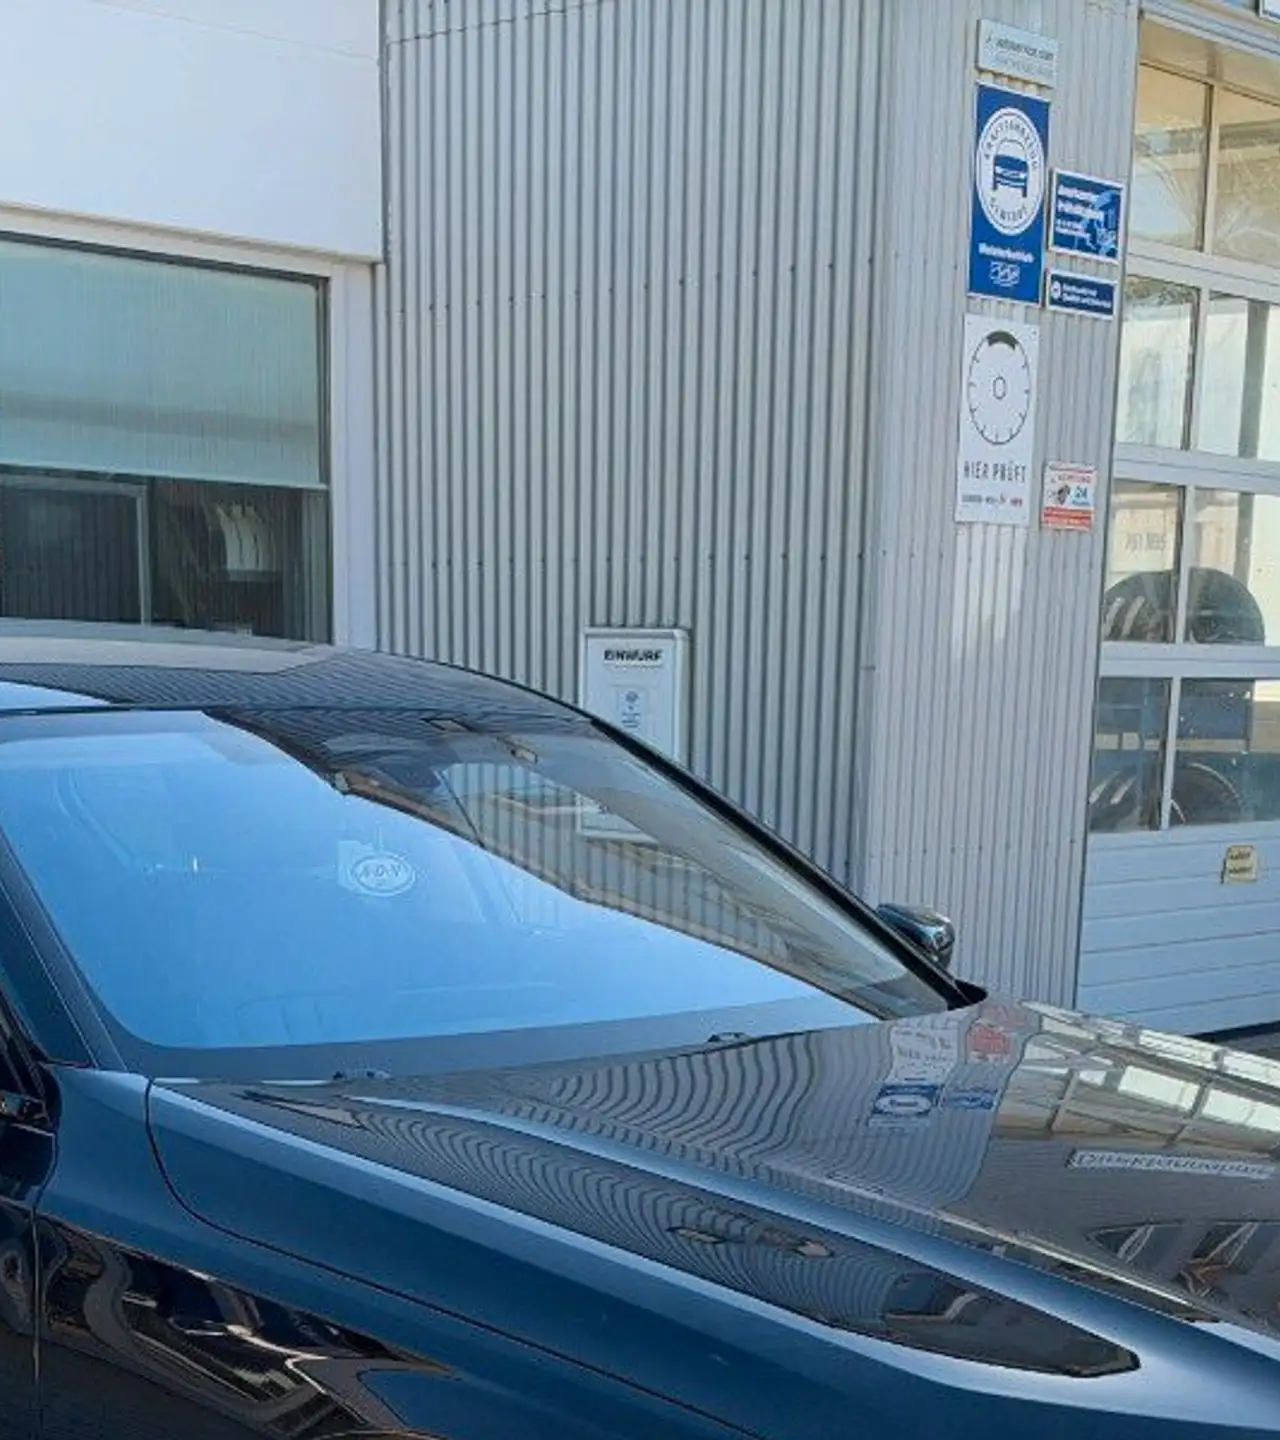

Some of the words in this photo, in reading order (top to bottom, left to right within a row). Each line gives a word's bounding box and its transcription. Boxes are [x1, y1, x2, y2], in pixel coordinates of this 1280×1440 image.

[963, 460, 989, 480] HIER
[992, 461, 1027, 484] PRÜFT
[604, 648, 663, 661] EINWURF
